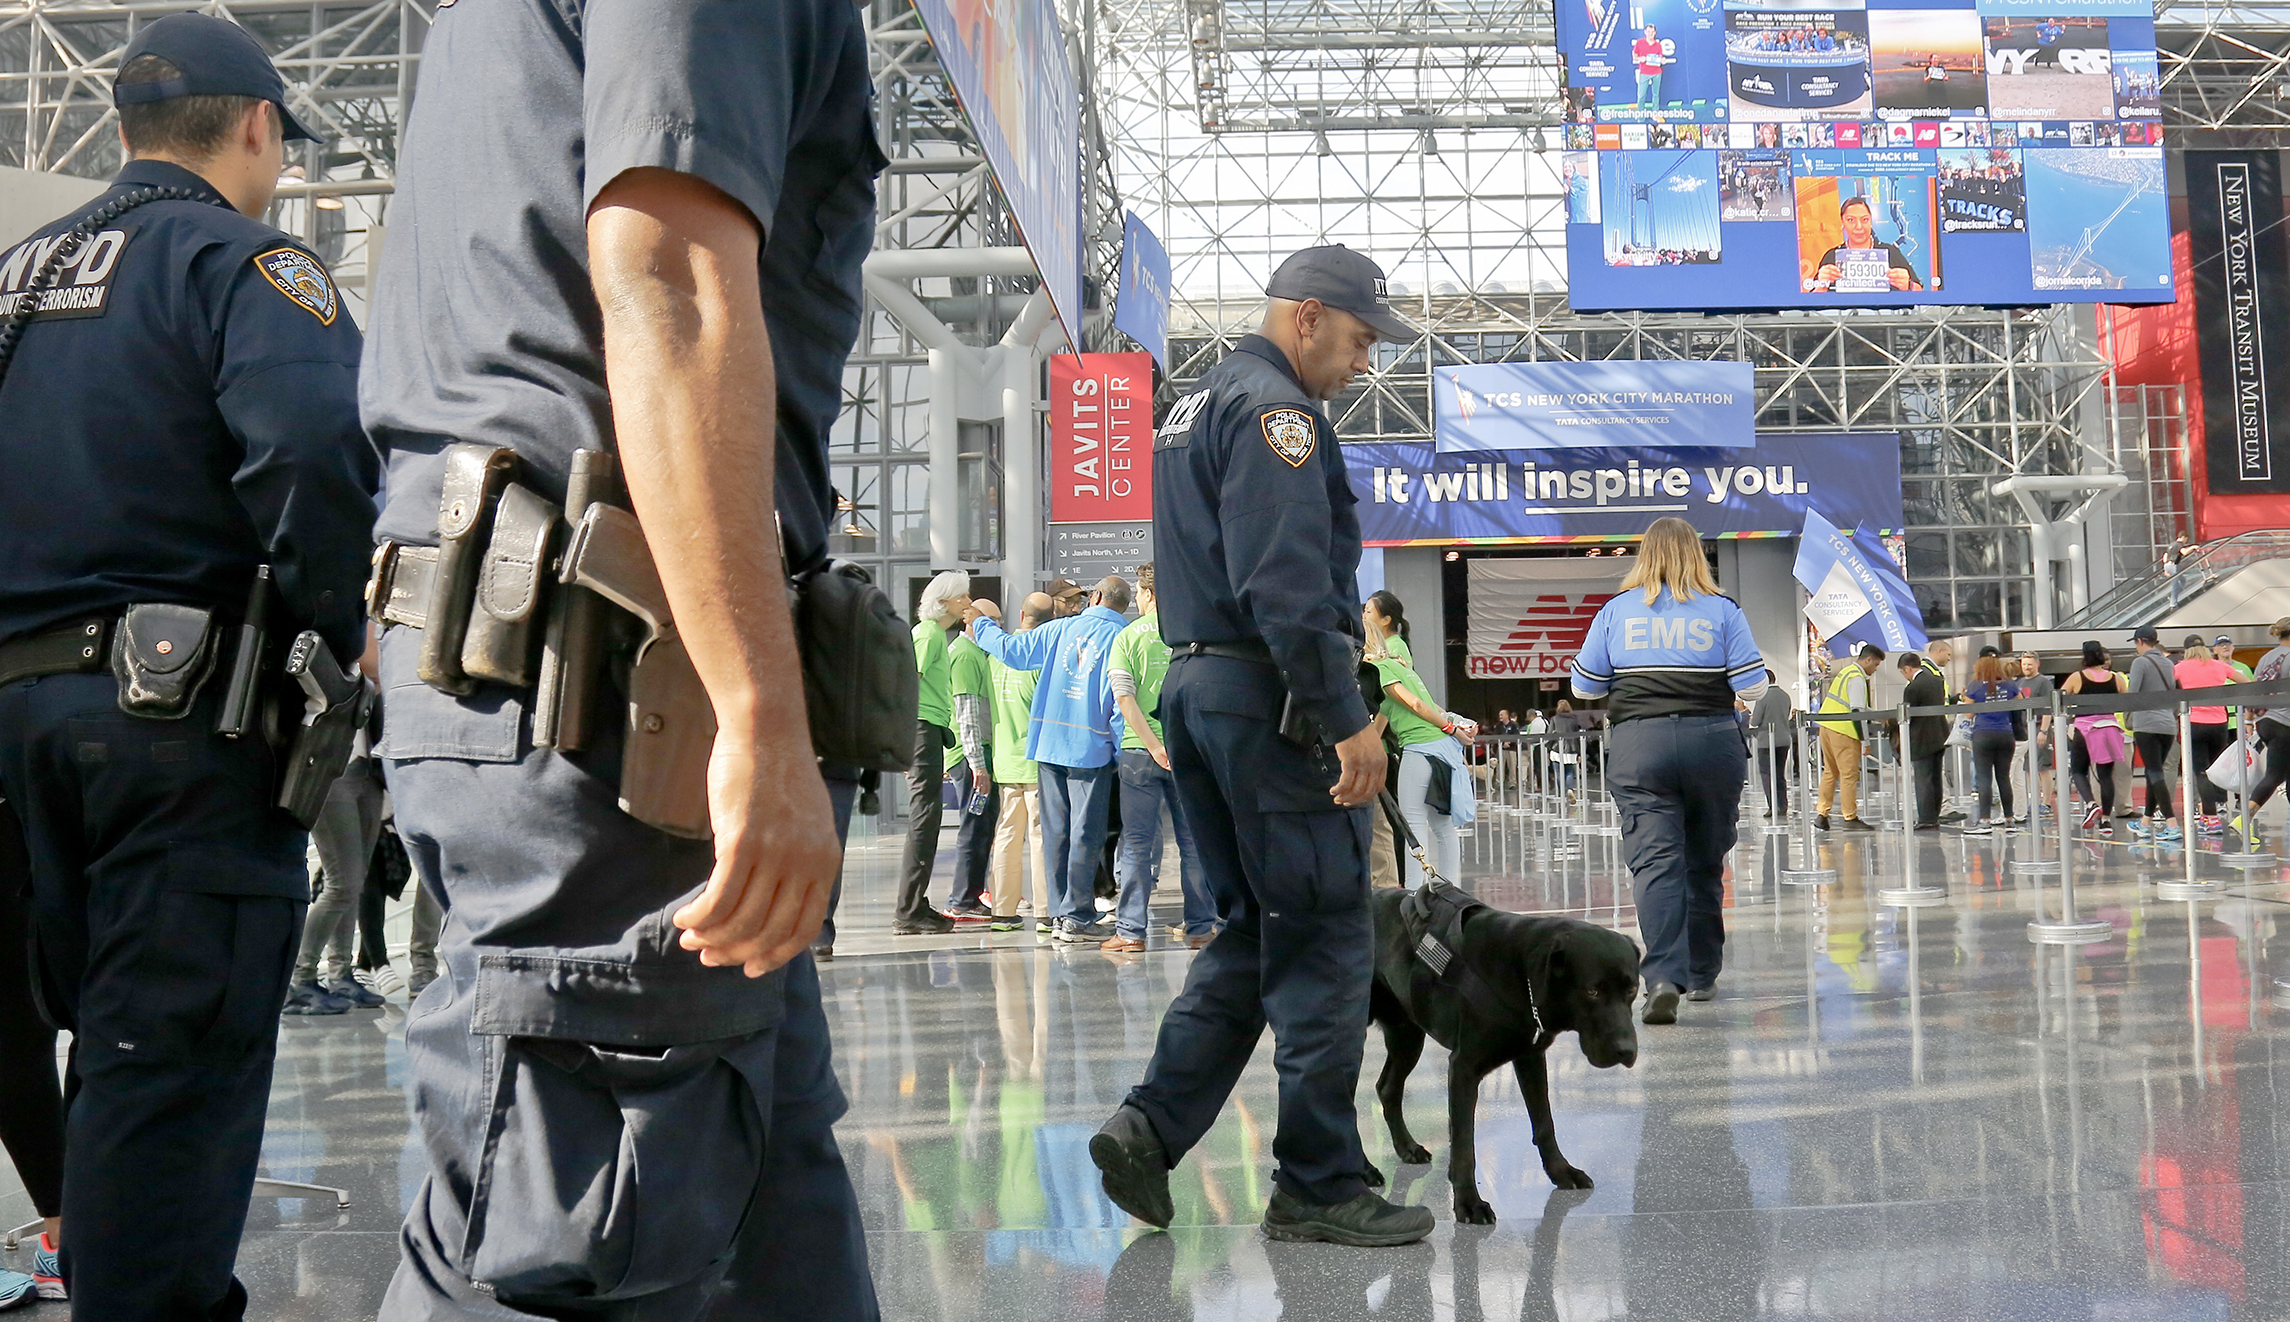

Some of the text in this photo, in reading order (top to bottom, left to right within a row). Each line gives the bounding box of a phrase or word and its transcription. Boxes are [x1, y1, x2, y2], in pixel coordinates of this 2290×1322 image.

[1600, 108, 1695, 120] @freshprincessblog
[1992, 107, 2057, 118] @melindanyrr
[1866, 152, 1919, 161] TRACK ME
[1946, 199, 2013, 226] TRACKS
[1849, 263, 1886, 277] 59300
[1142, 266, 1155, 294] TCS
[275, 278, 300, 296] CITY
[298, 296, 315, 307] OF
[1483, 391, 1733, 408] TCS NEW YORK CITY MARATHON
[1267, 417, 1310, 429] DEPARTMENT
[1275, 412, 1299, 420] POLICE
[1555, 416, 1669, 426] TATA CONSULTANCY SERVICES
[1072, 377, 1099, 497] JAVITS
[1110, 376, 1132, 497] CENTER
[1269, 435, 1289, 456] CITY OF
[1373, 460, 1809, 506] It will inspire you.
[1092, 549, 1112, 557] North,
[1072, 566, 1081, 574] 1E
[1828, 534, 1905, 650] TCS NEW YORK CITY
[1814, 600, 1862, 609] CONSULTANCY
[1624, 617, 1714, 652] EMS
[1471, 655, 1531, 674] new
